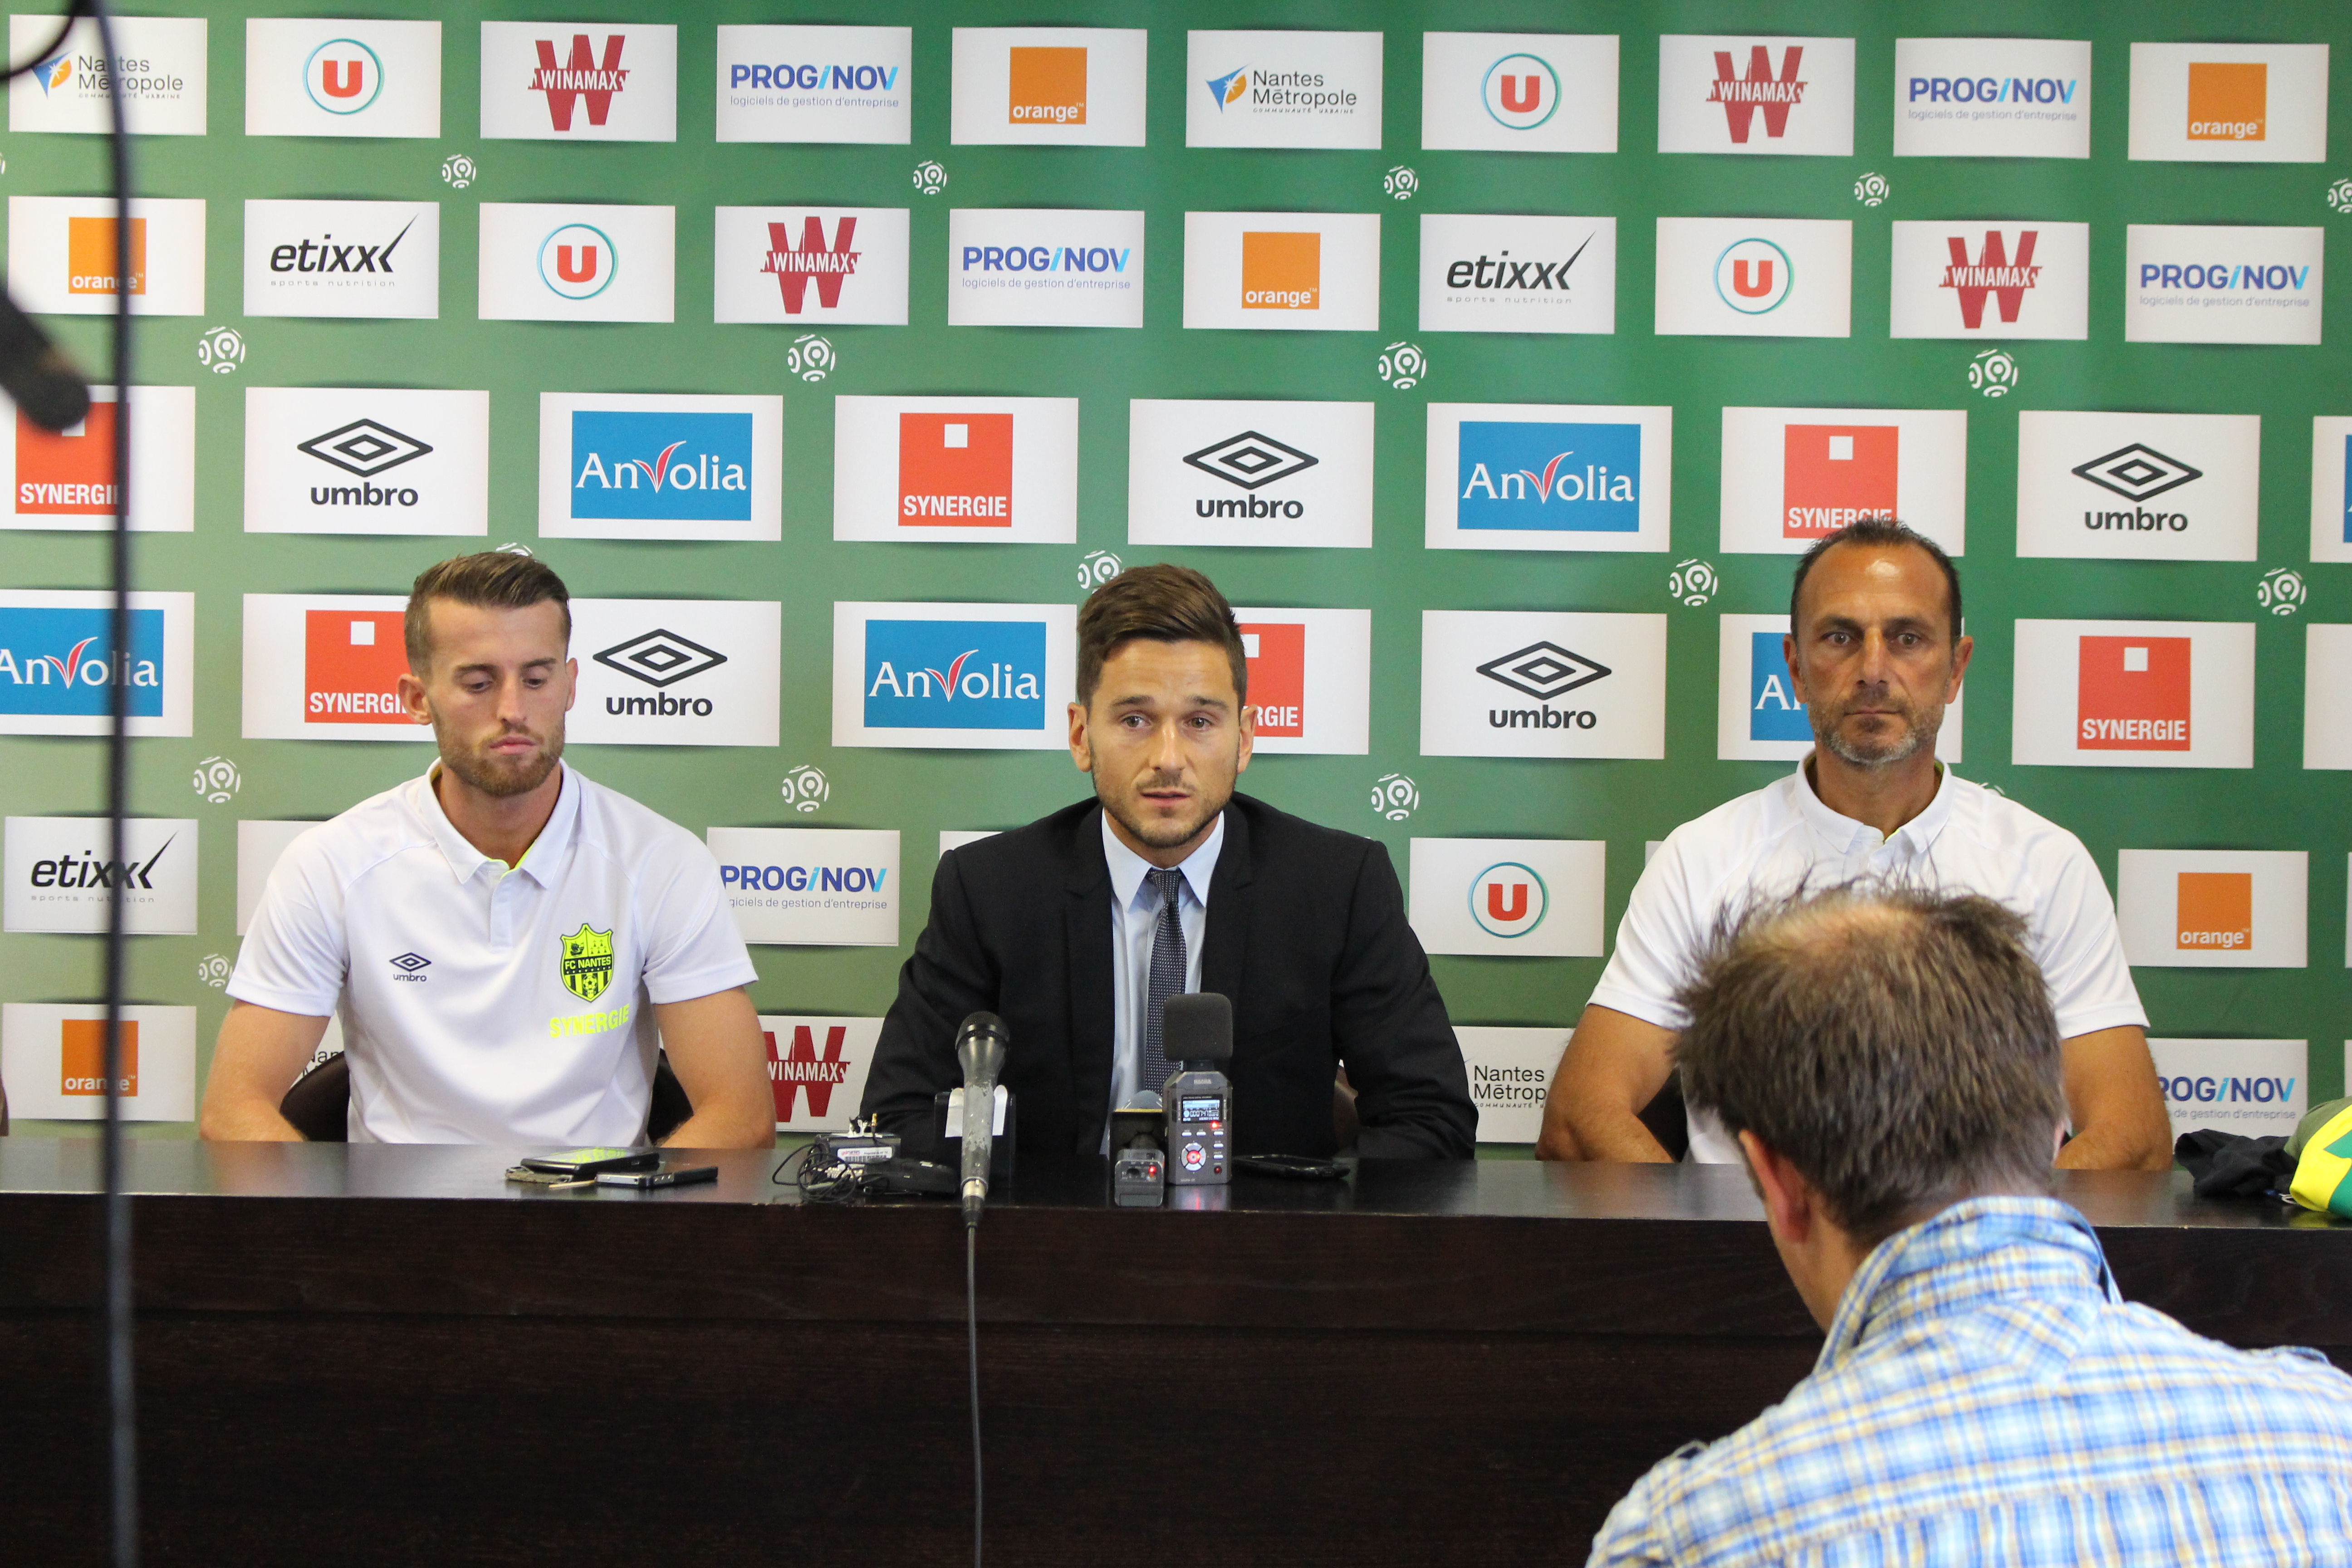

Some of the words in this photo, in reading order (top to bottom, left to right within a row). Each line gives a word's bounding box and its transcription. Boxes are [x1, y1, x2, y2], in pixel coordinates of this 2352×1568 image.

[79, 56, 149, 72] Nates
[323, 60, 363, 98] U
[543, 69, 617, 90] WINAMAX
[1254, 70, 1323, 87] Nantes
[1501, 75, 1540, 113] U
[1719, 82, 1796, 103] WINAMAX
[1014, 106, 1077, 122] orange
[2191, 122, 2257, 137] orange
[270, 231, 393, 272] etixx
[557, 245, 597, 283] U
[773, 252, 849, 273] WINAMAX
[1447, 248, 1570, 289] etixx
[72, 275, 137, 291] orane
[962, 277, 1005, 289] logiciels
[1009, 278, 1021, 287] de
[1024, 279, 1064, 289] gestion
[1067, 279, 1131, 290] d'entreprise
[1733, 260, 1773, 298] U
[1953, 267, 2031, 287] WINAMAX
[1246, 291, 1310, 306] orange
[311, 482, 418, 506] umbro
[904, 495, 1007, 516] SYNERGIE
[1196, 494, 1303, 519] umbro
[2085, 507, 2188, 531] umbro
[310, 692, 407, 714] SYNERGI
[607, 692, 712, 716] umbro
[1490, 705, 1596, 729] umbro
[2082, 719, 2186, 740] SYNERGIE
[729, 897, 763, 907] giciels
[766, 897, 779, 906] de
[782, 899, 821, 909] gestion
[1488, 884, 1528, 921] U
[2181, 931, 2243, 947] orange
[565, 960, 576, 970] FC
[578, 956, 611, 968] NANTES
[394, 972, 427, 982] umbro
[549, 1004, 630, 1038] SYNERGIE
[1475, 1065, 1544, 1082] Nantes
[64, 1078, 130, 1091] orane
